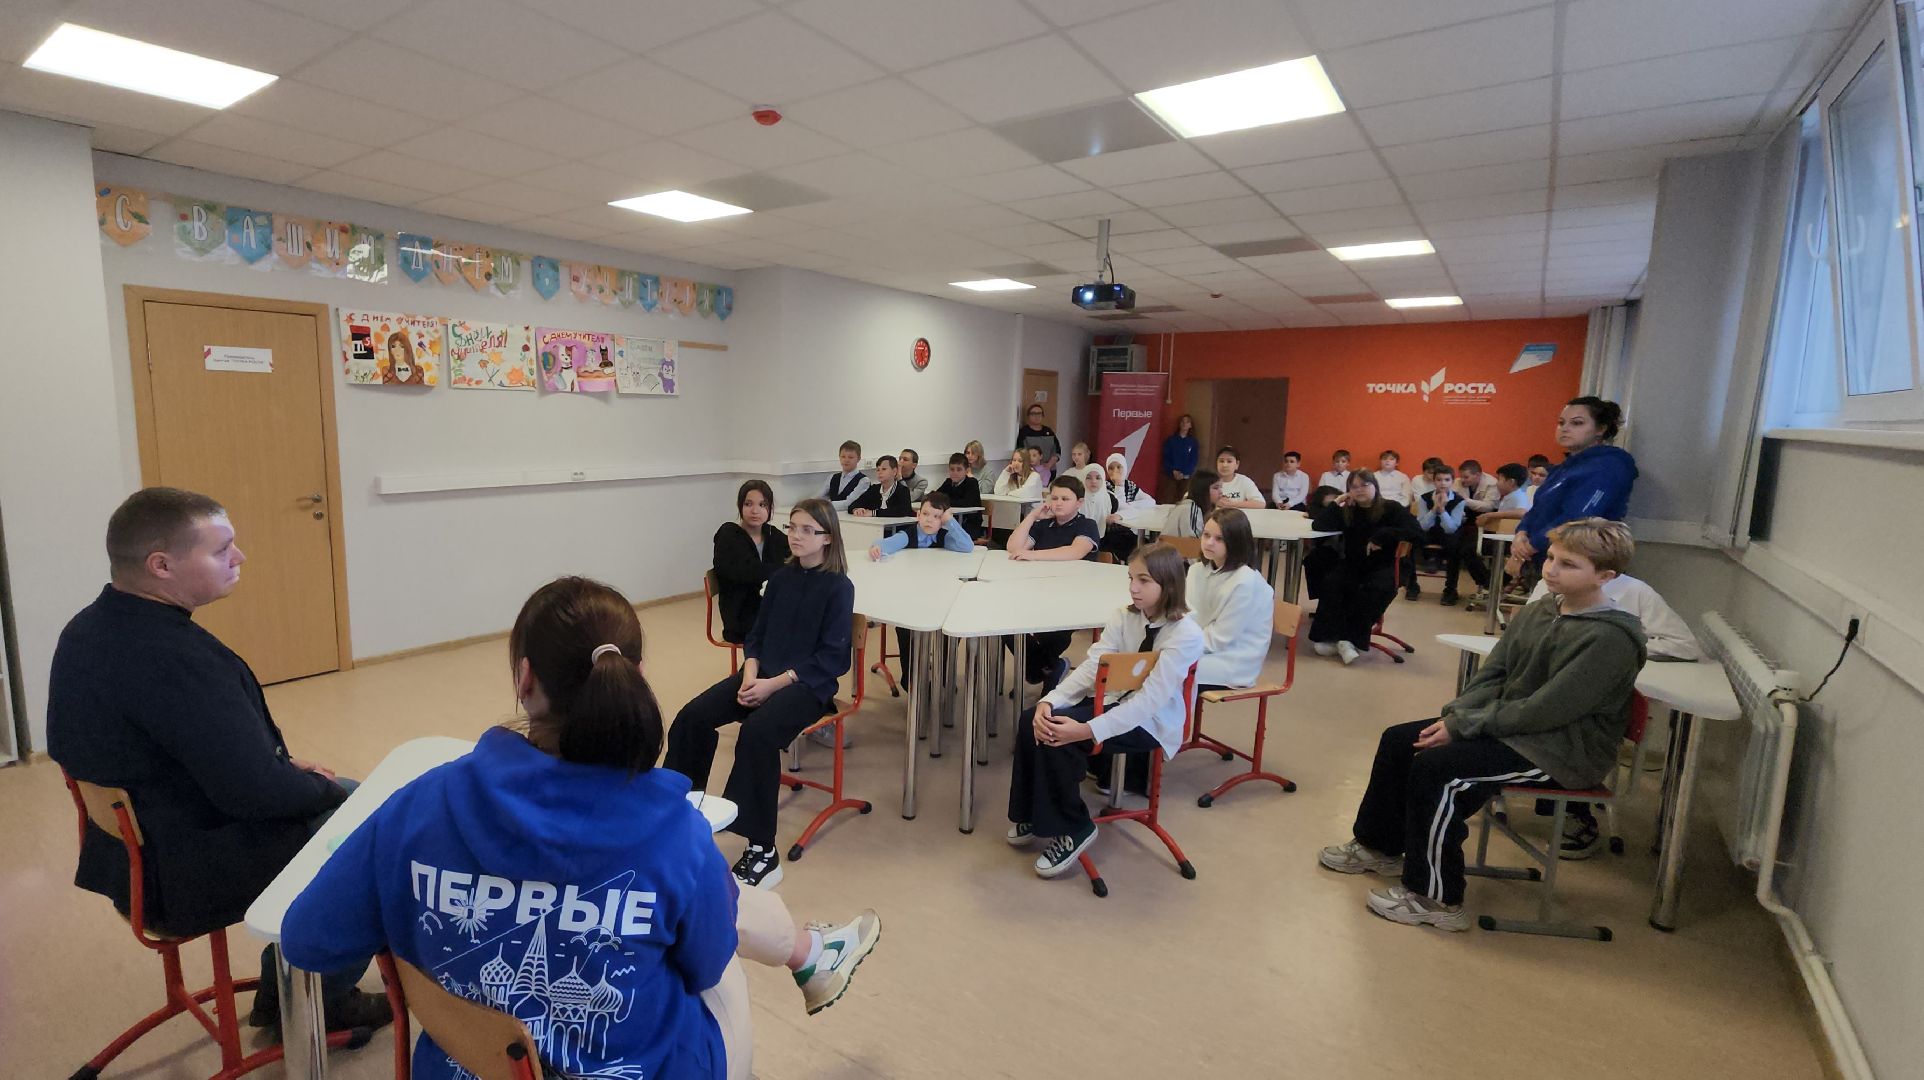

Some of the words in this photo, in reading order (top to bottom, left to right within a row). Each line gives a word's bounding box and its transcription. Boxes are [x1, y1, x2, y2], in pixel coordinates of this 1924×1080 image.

[115, 194, 132, 232] С
[192, 204, 375, 265] ВАШИМ
[1366, 382, 1418, 394] ТОЧКА
[1443, 382, 1497, 394] РОСТА
[1112, 408, 1153, 421] Первые
[410, 859, 657, 936] ПЕРВЫЕ
